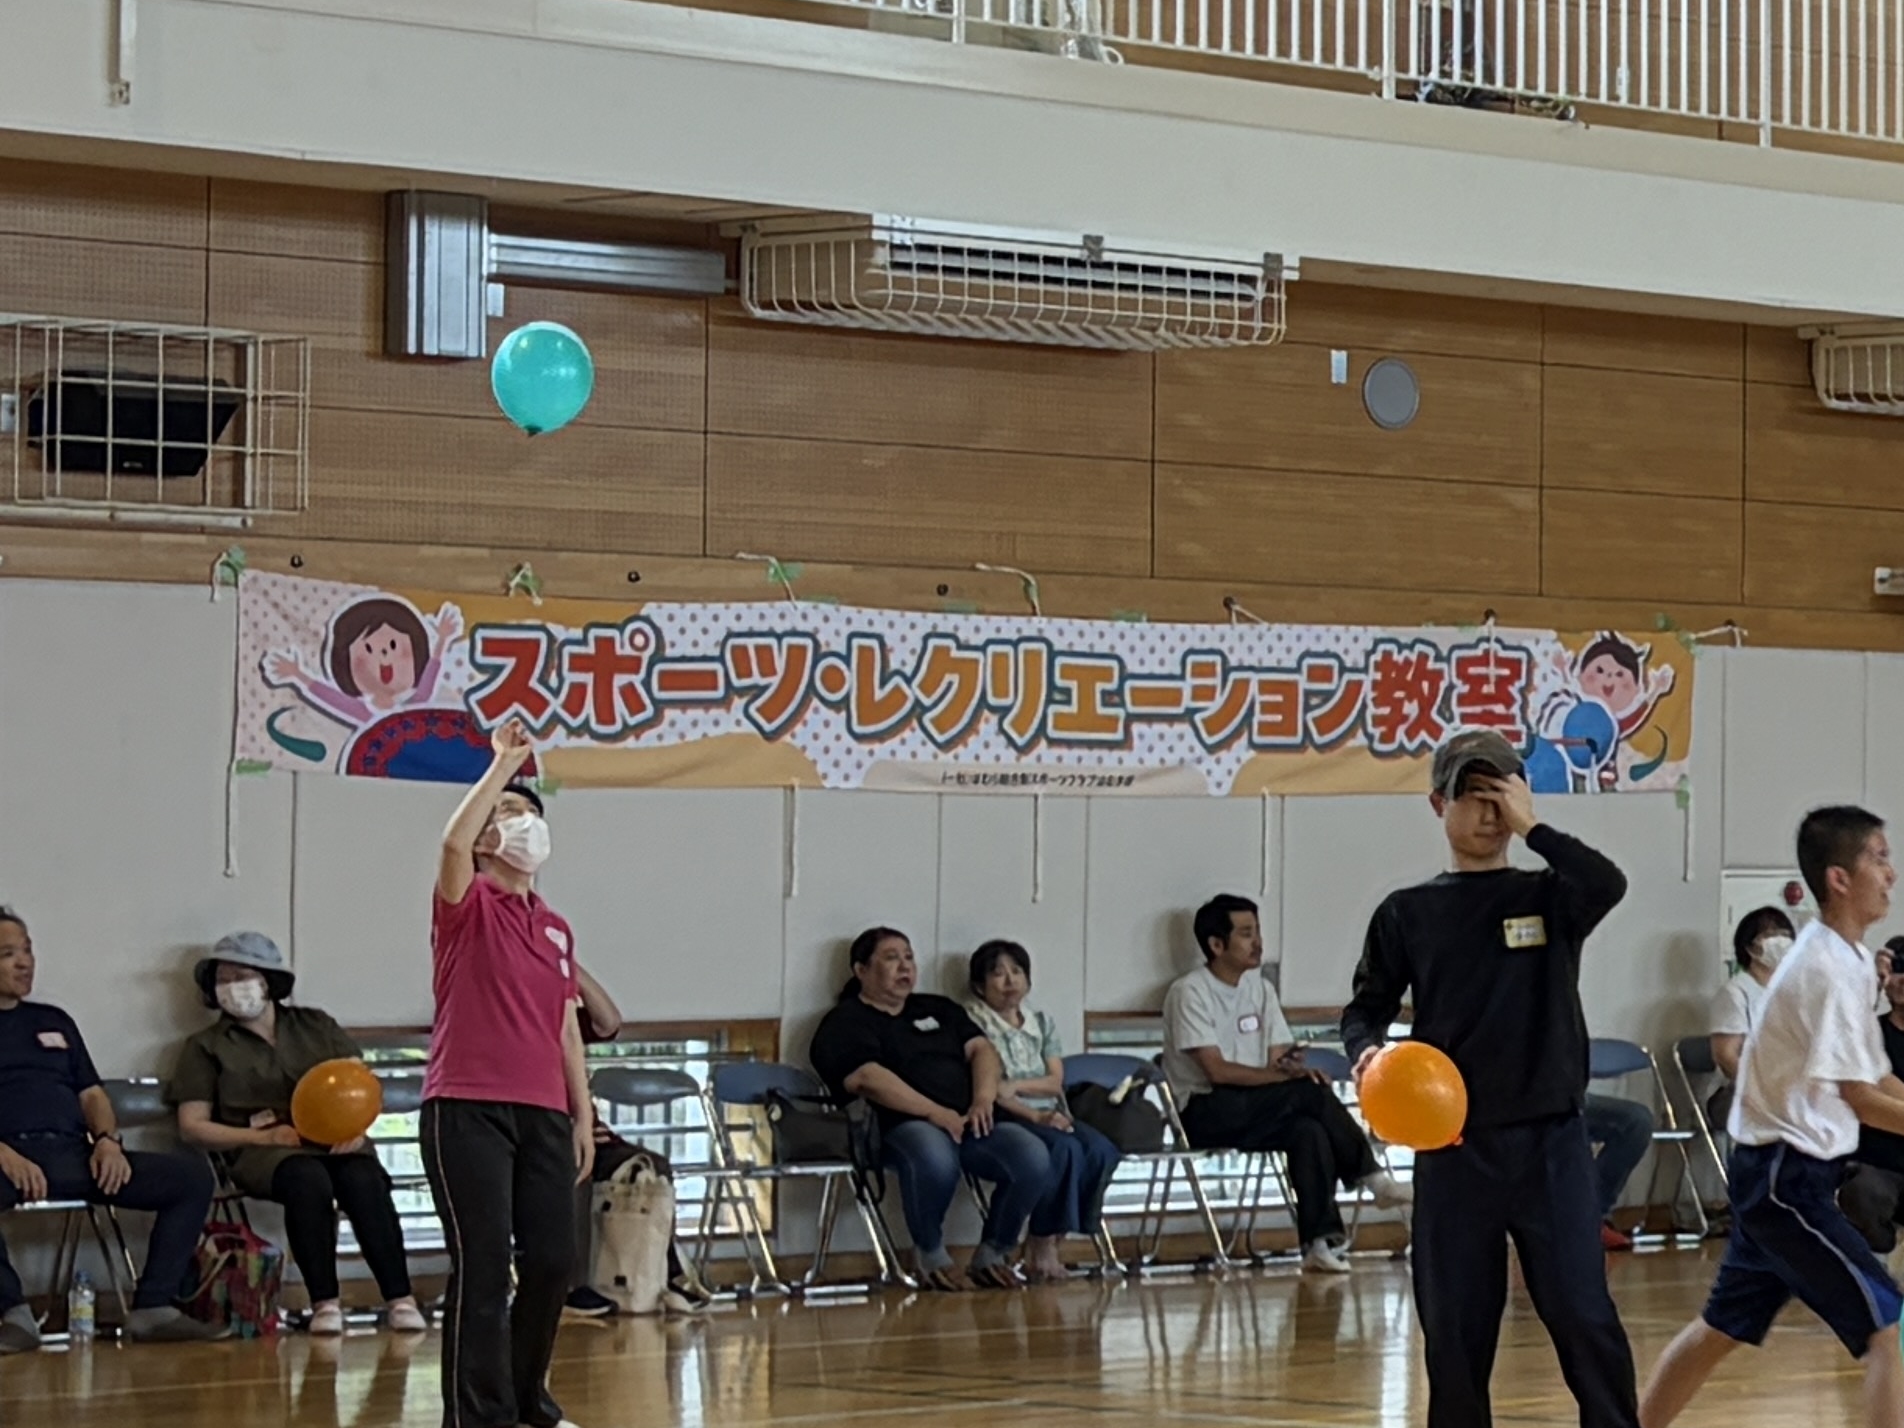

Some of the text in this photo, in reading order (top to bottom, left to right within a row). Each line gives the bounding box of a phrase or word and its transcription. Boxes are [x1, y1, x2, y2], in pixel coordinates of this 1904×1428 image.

[469, 624, 1526, 749] スポーツ・レクリエーション教室
